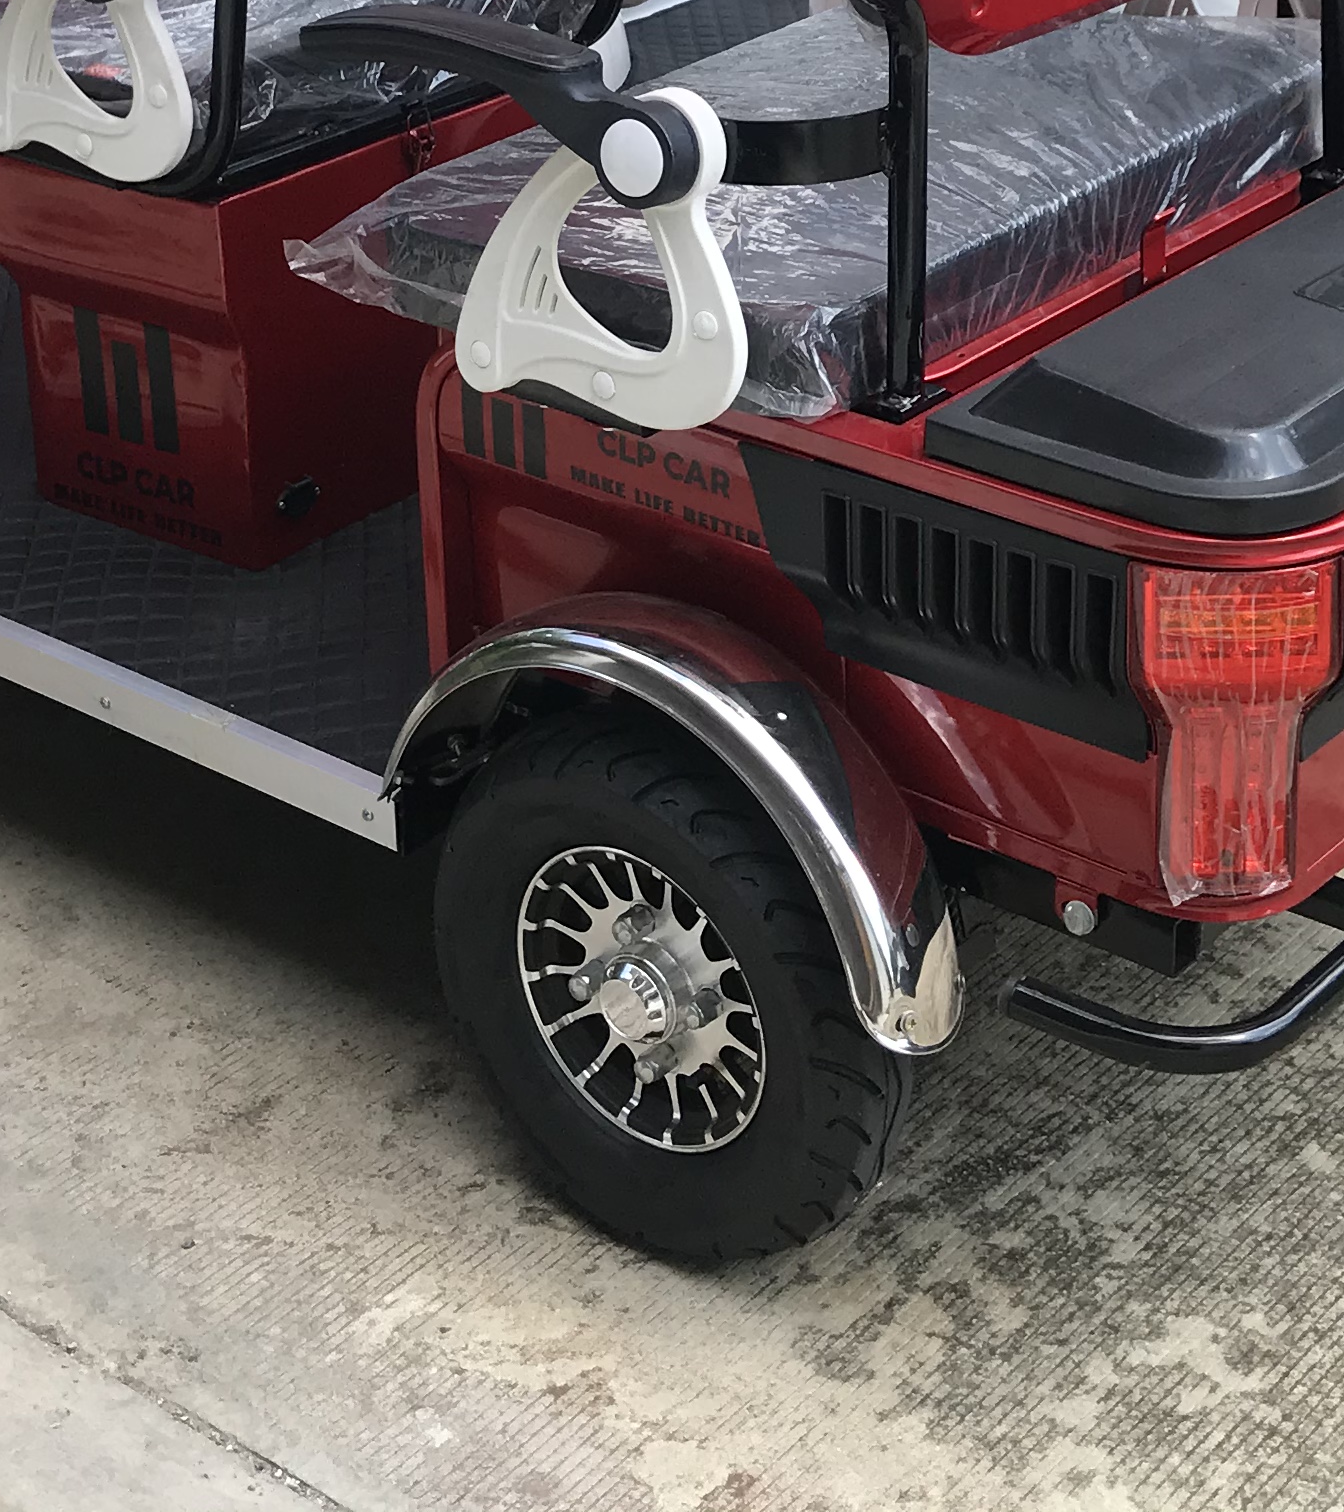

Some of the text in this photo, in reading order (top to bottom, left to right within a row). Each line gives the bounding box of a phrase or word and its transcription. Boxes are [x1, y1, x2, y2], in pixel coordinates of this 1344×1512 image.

[78, 451, 196, 509] CLP CAR
[597, 427, 730, 499] CLP CAR
[570, 465, 761, 548] MAKE LIFE BETTER
